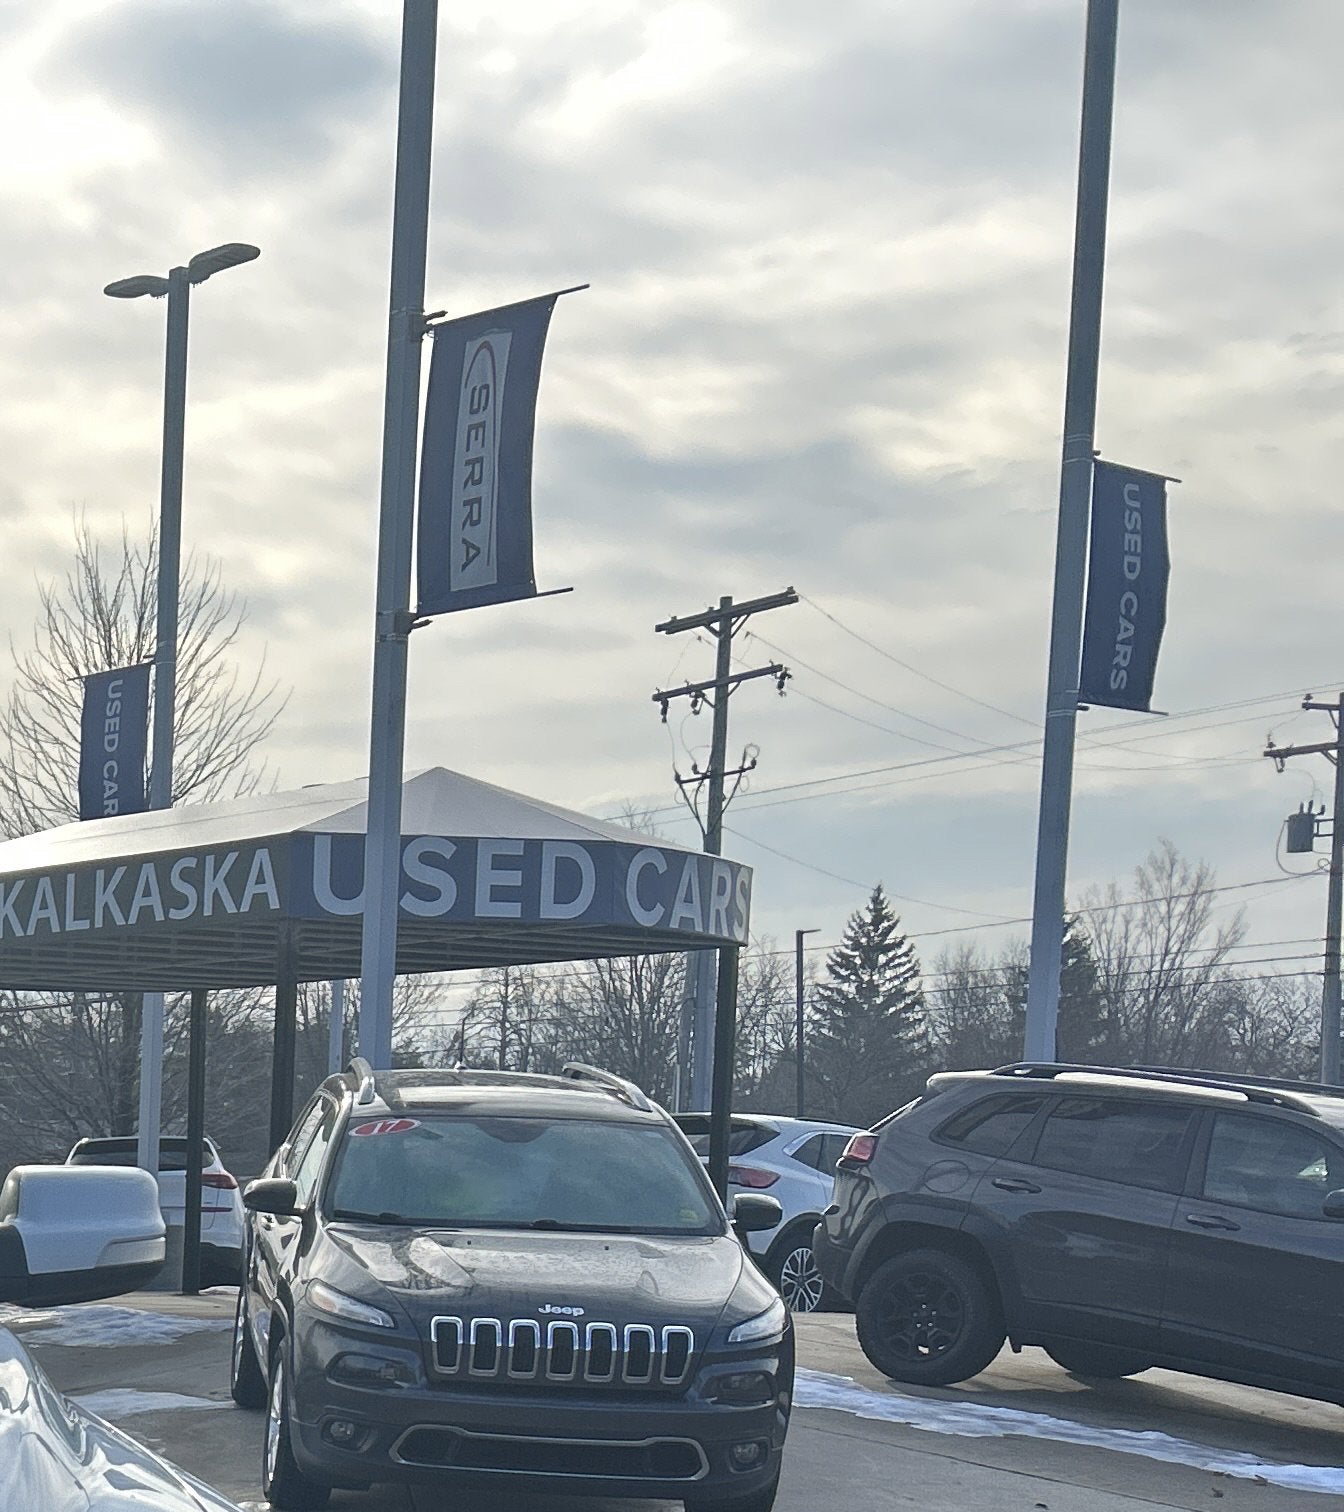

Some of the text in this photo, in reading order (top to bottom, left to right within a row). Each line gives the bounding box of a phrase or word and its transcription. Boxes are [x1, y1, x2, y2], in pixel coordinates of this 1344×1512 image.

[462, 382, 491, 573] SERRA
[1110, 482, 1142, 690] USED CARS
[103, 679, 124, 816] USED CAR
[313, 835, 750, 942] USED CARS
[538, 1303, 585, 1316] Jeep
